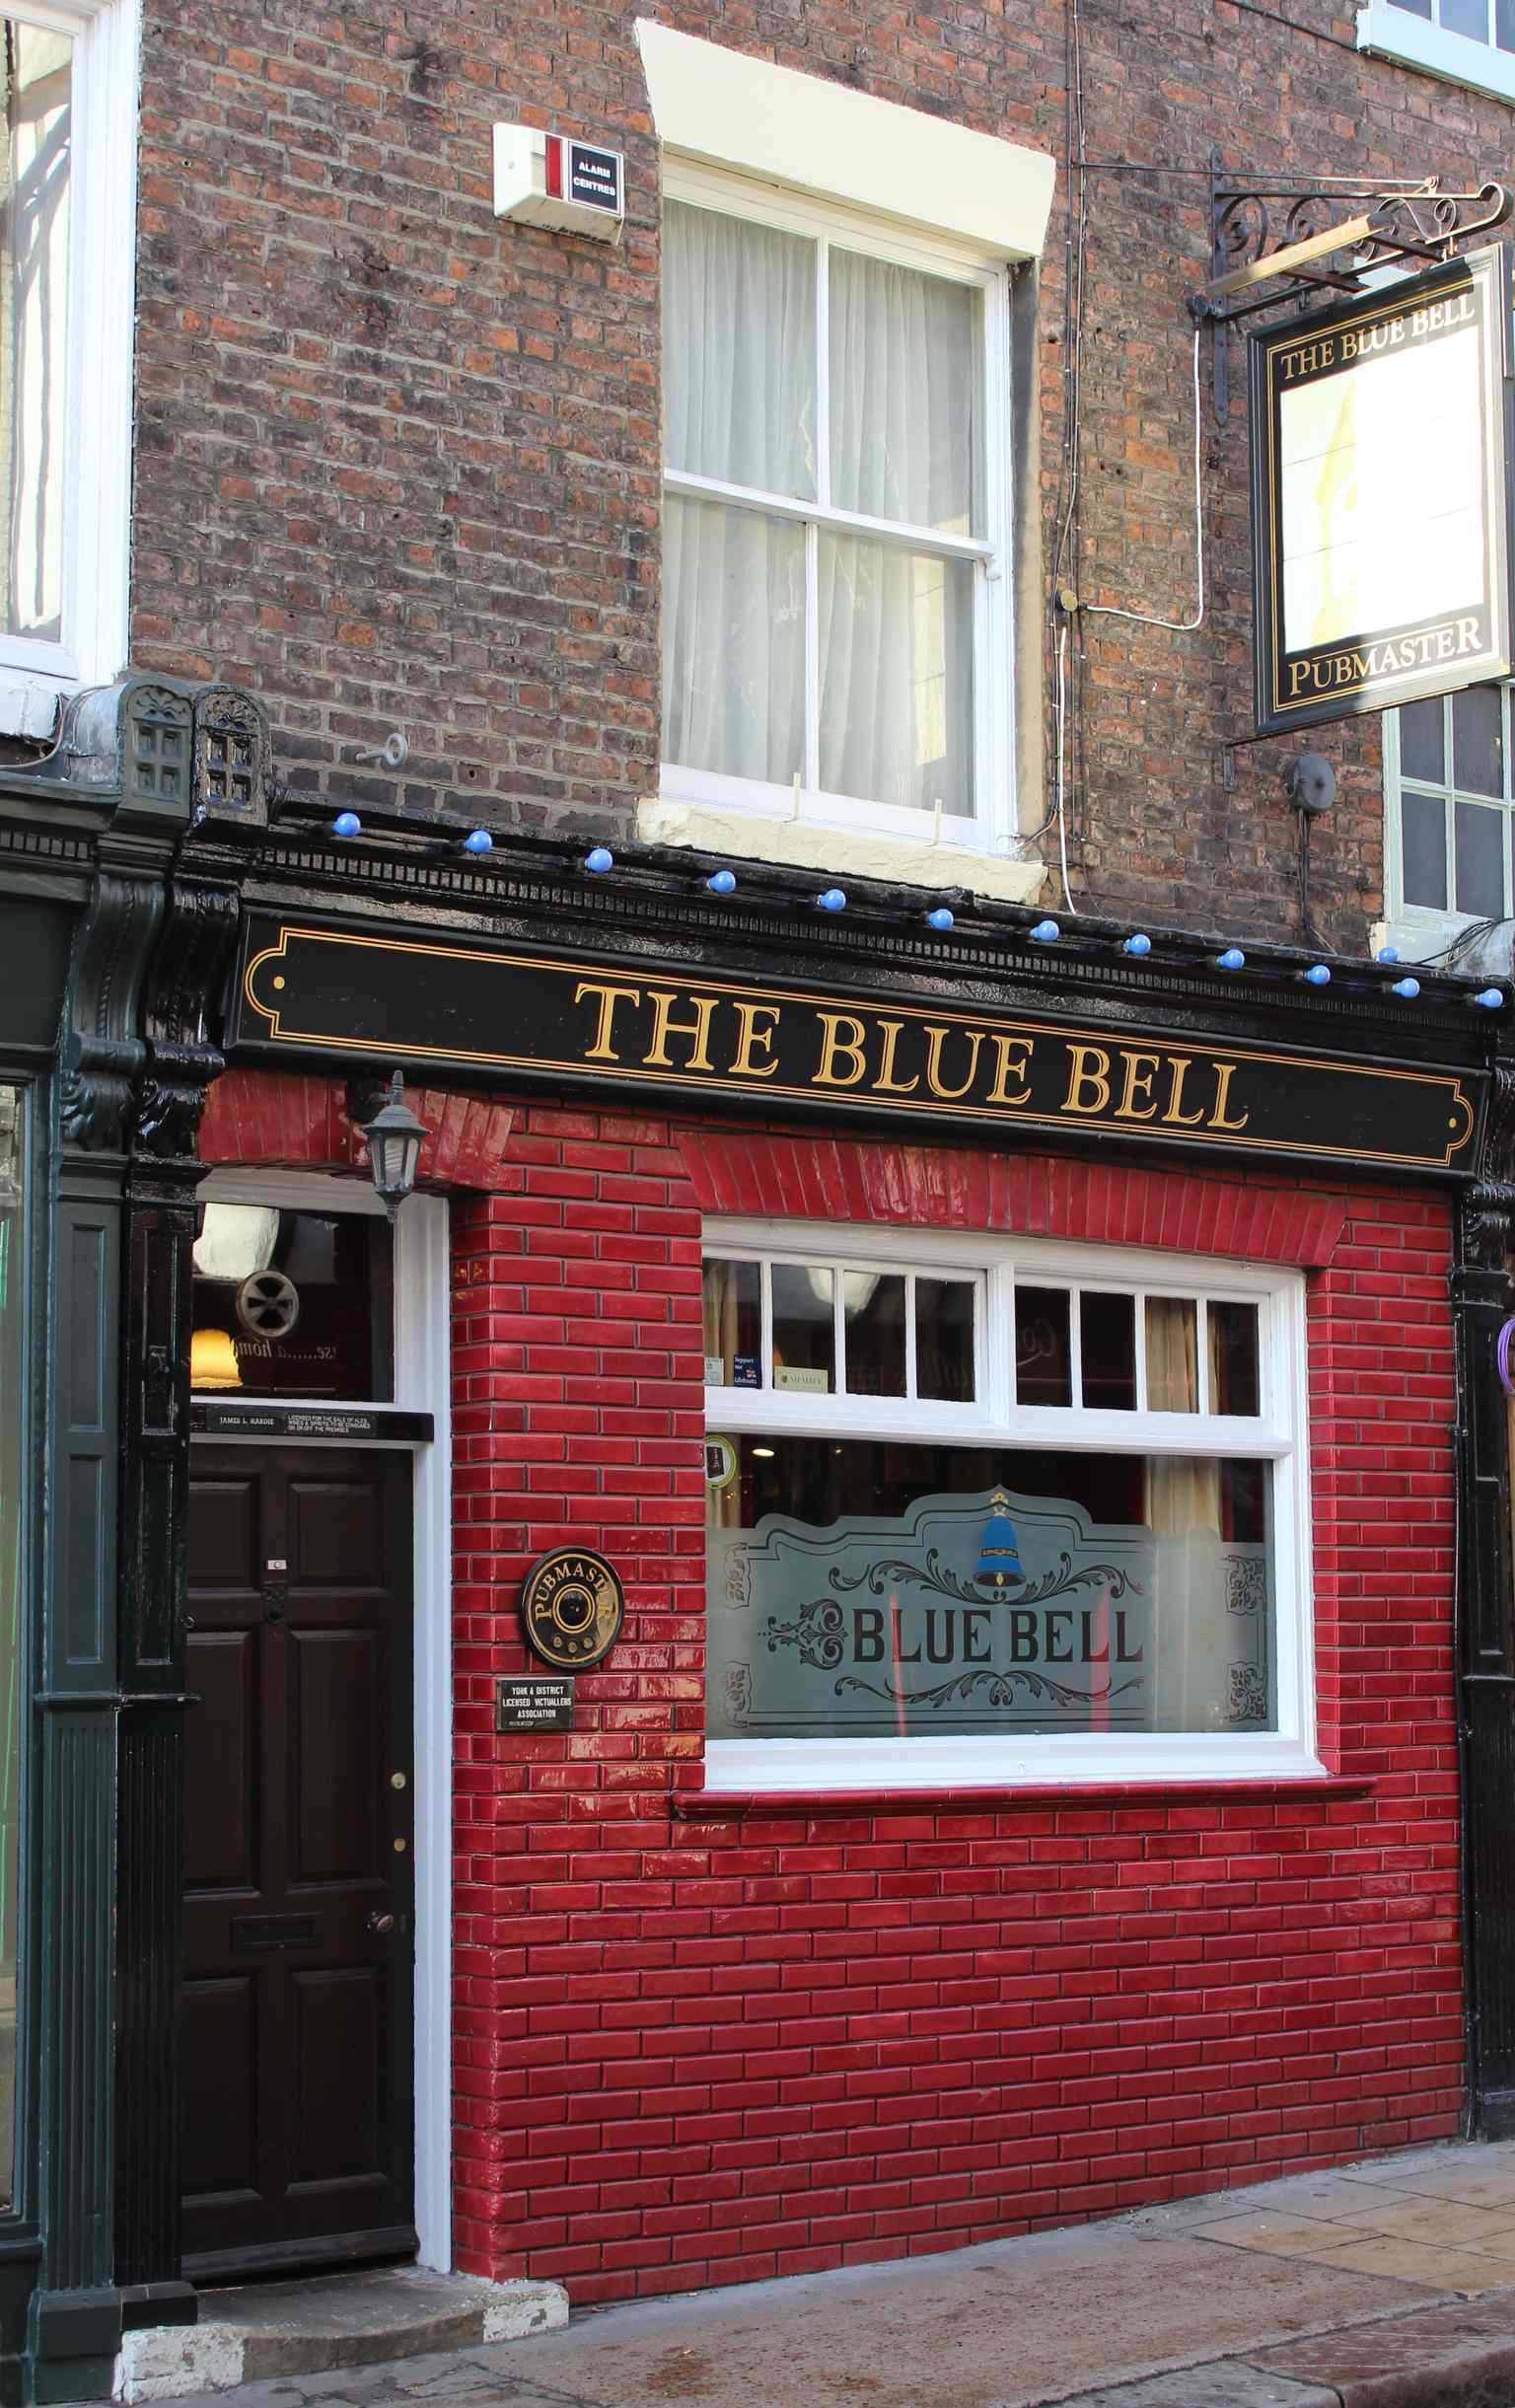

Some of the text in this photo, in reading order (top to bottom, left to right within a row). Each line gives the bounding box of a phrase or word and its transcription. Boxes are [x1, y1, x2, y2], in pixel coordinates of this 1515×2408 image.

[573, 177, 616, 196] CENTRES
[579, 161, 611, 179] ALARM
[1280, 293, 1476, 380] THE BLUE BELL
[1288, 617, 1483, 696] PUBMASTER
[574, 983, 1250, 1131] THE BLUE BELL
[536, 1562, 613, 1621] PUBMAST
[852, 1608, 1143, 1664] BLUE BELL
[503, 1697, 571, 1707] LICENSED VICTUALLERS
[512, 1686, 528, 1695] YORK
[537, 1686, 564, 1695] DISTRICT
[518, 1709, 556, 1718] ASSOCIATION
